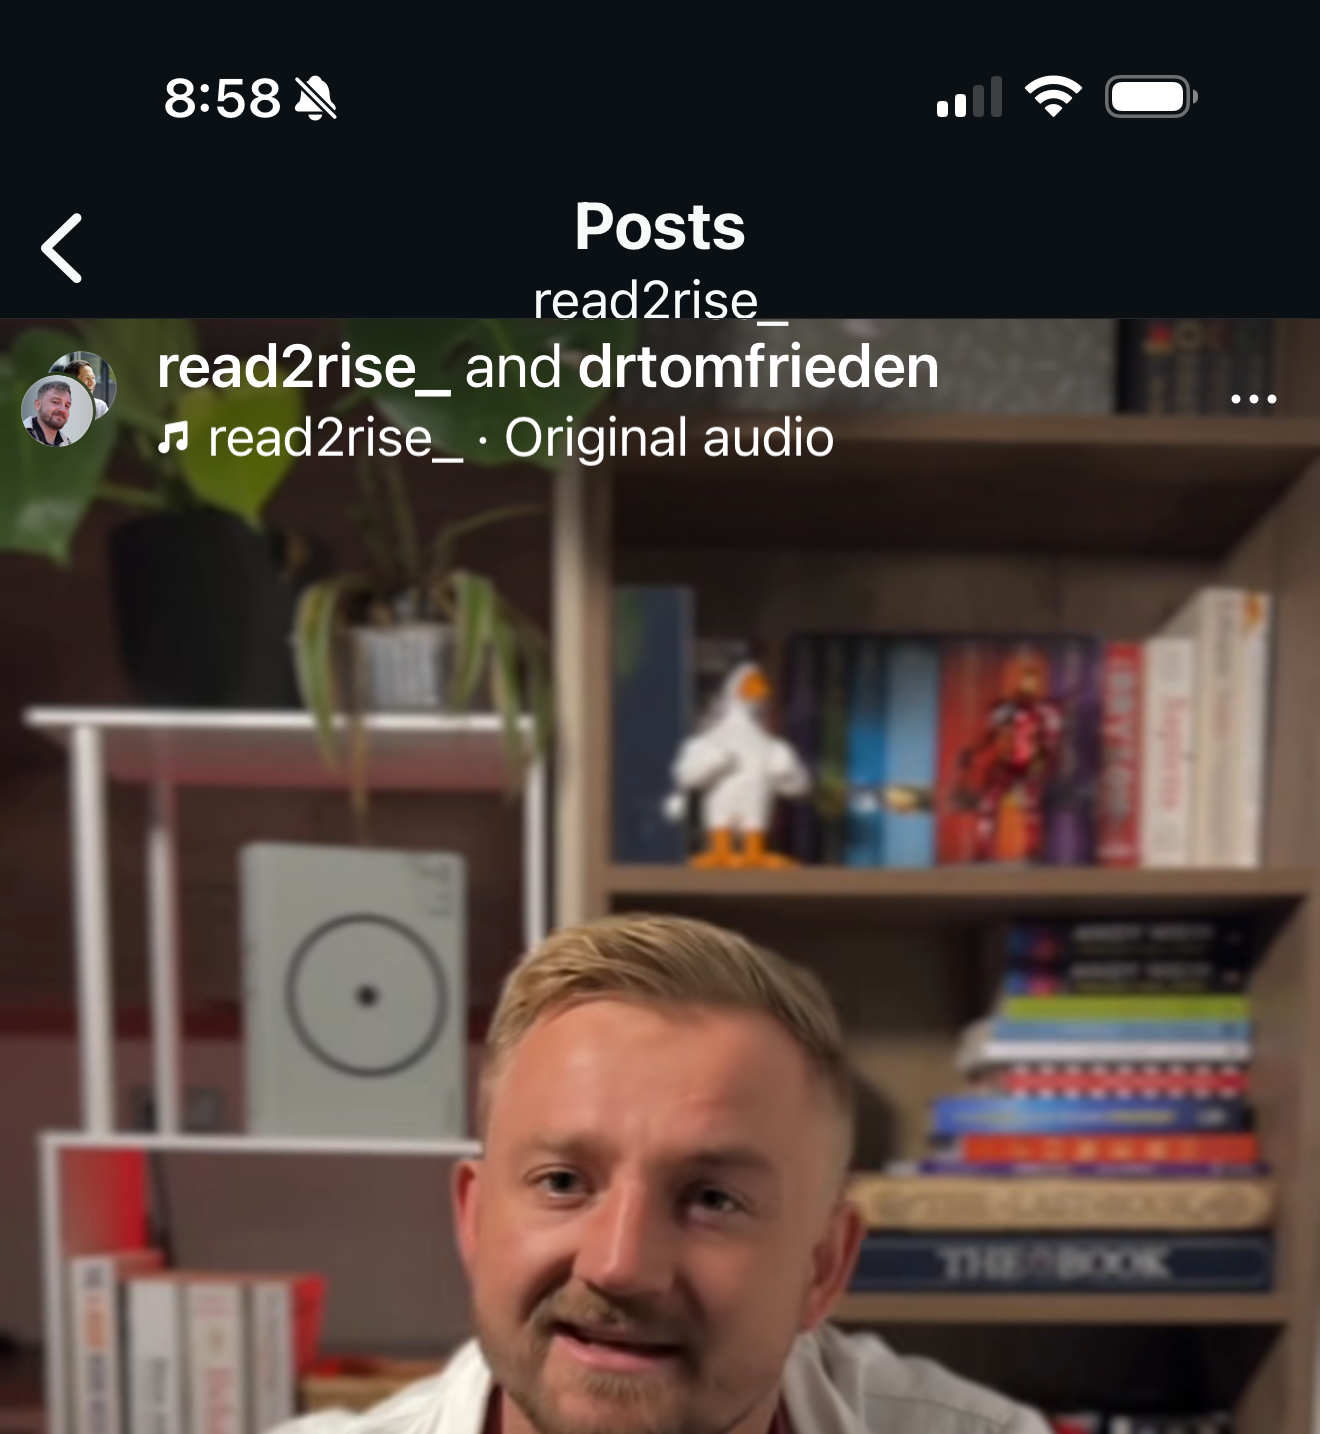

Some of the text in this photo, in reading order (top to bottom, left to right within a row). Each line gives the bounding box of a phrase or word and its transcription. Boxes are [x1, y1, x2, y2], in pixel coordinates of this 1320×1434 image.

[164, 77, 281, 119] 8:58
[577, 201, 745, 251] Posts
[535, 278, 789, 327] read2rise_
